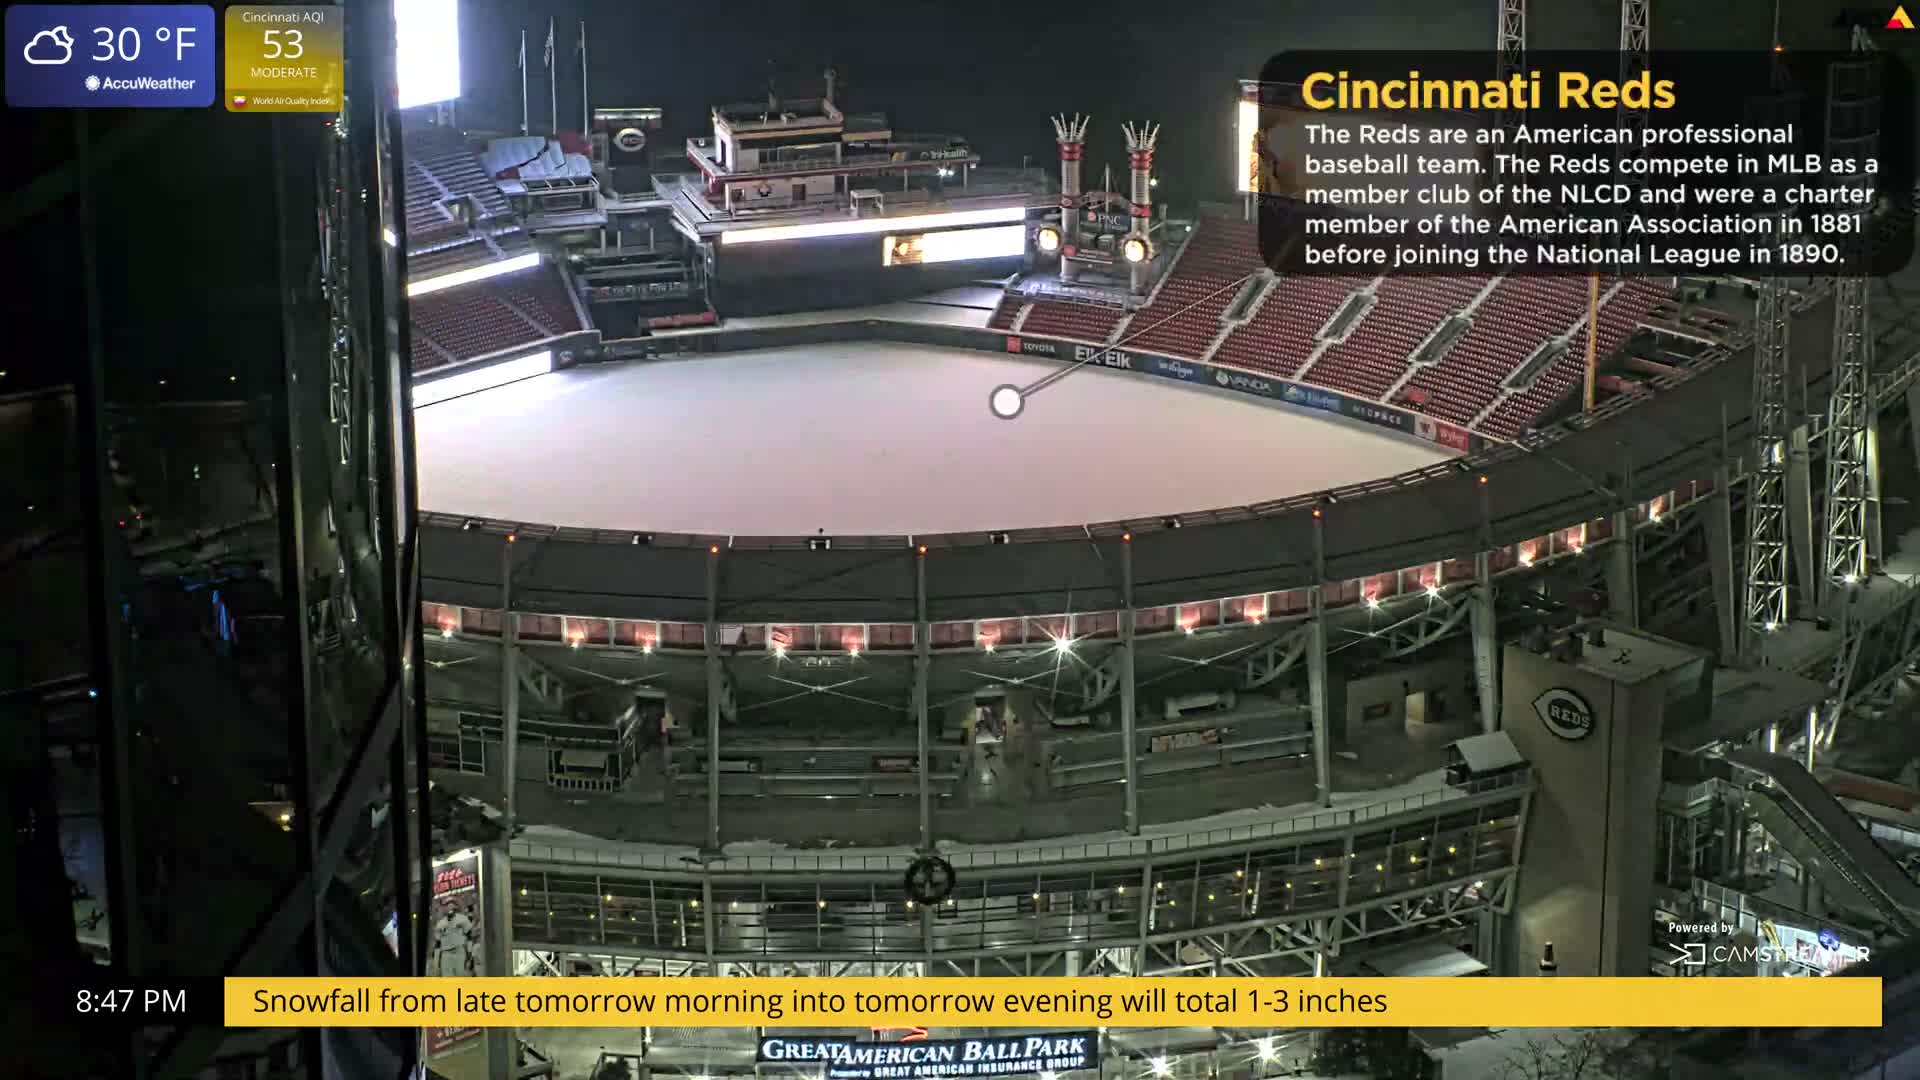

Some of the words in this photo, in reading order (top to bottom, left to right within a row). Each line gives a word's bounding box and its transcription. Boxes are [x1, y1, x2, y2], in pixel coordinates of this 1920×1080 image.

[1098, 214, 1120, 225] PNC
[1023, 342, 1055, 353] TOYOTA
[1228, 375, 1272, 392] VANDA
[1352, 404, 1401, 425] MEDPACE
[1551, 704, 1591, 729] REDS
[874, 1066, 912, 1077] GREAT
[914, 1062, 974, 1076] AMERICAN
[978, 1058, 1042, 1074] INSURANCE
[1046, 1056, 1085, 1070] GROUP
